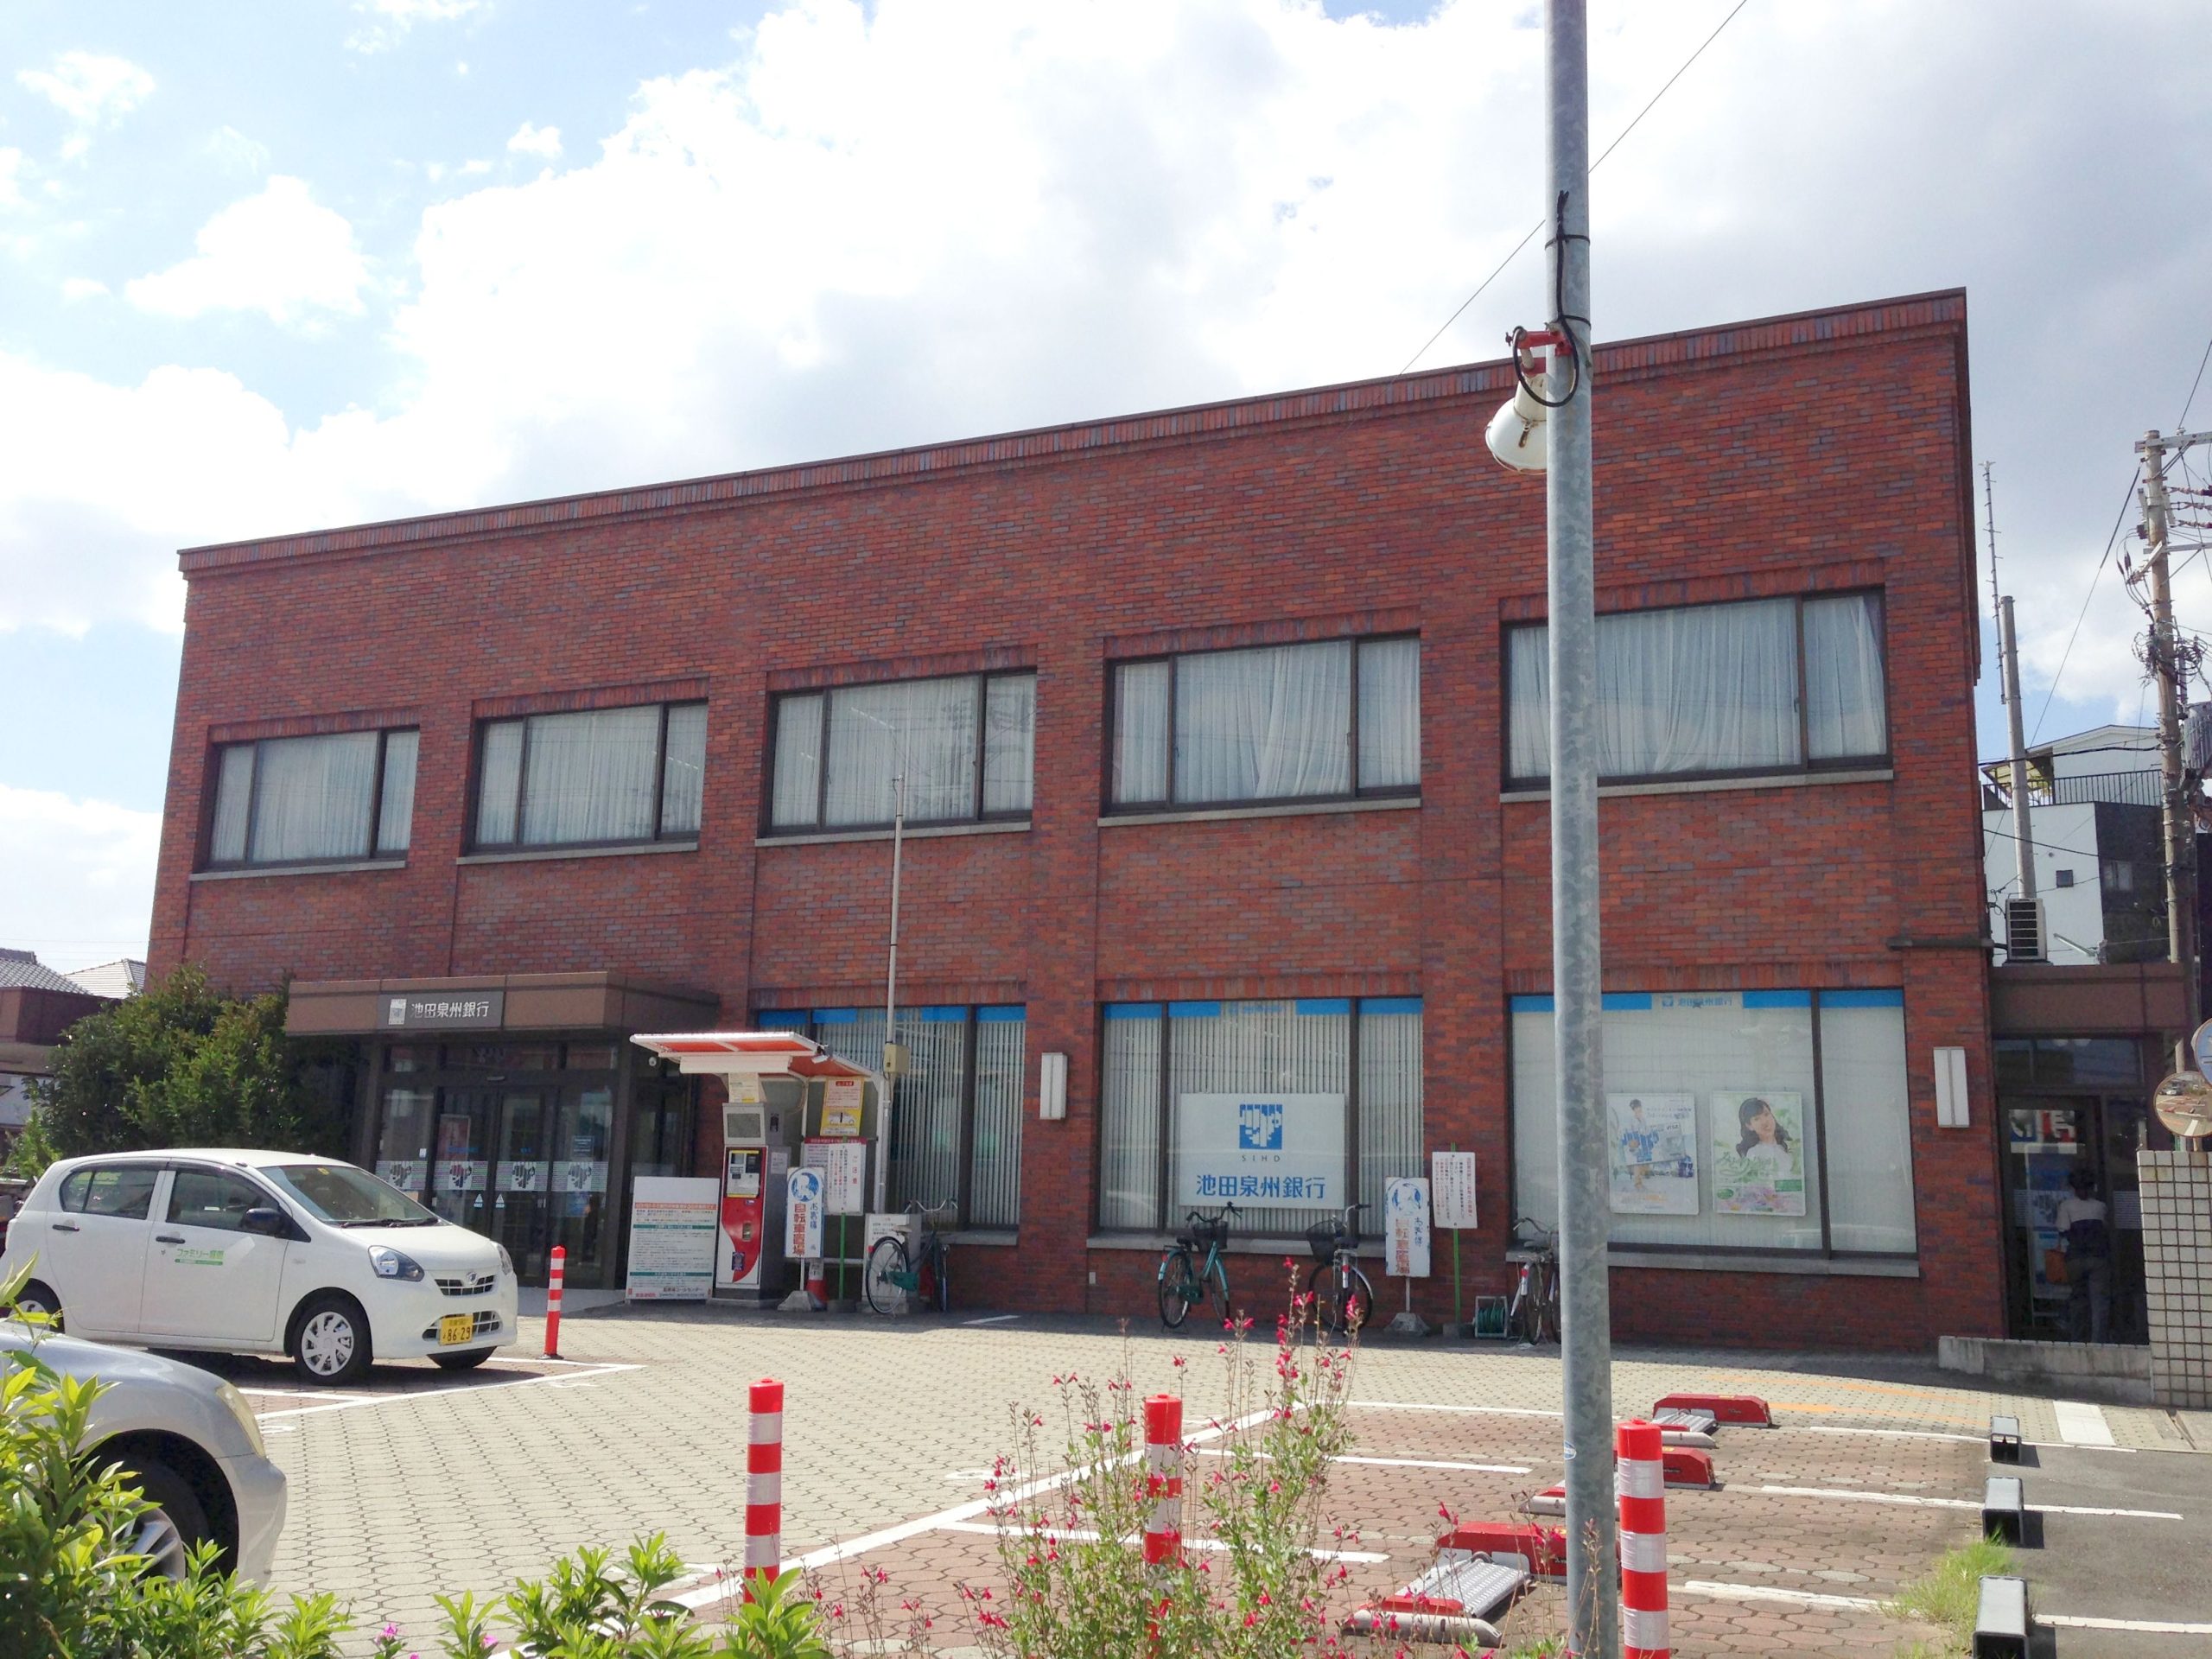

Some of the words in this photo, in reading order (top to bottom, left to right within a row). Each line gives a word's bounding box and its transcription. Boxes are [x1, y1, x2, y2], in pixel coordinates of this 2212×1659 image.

[411, 1001, 490, 1019] 池田泉州銀行
[1196, 1174, 1325, 1198] 池田泉州銀行
